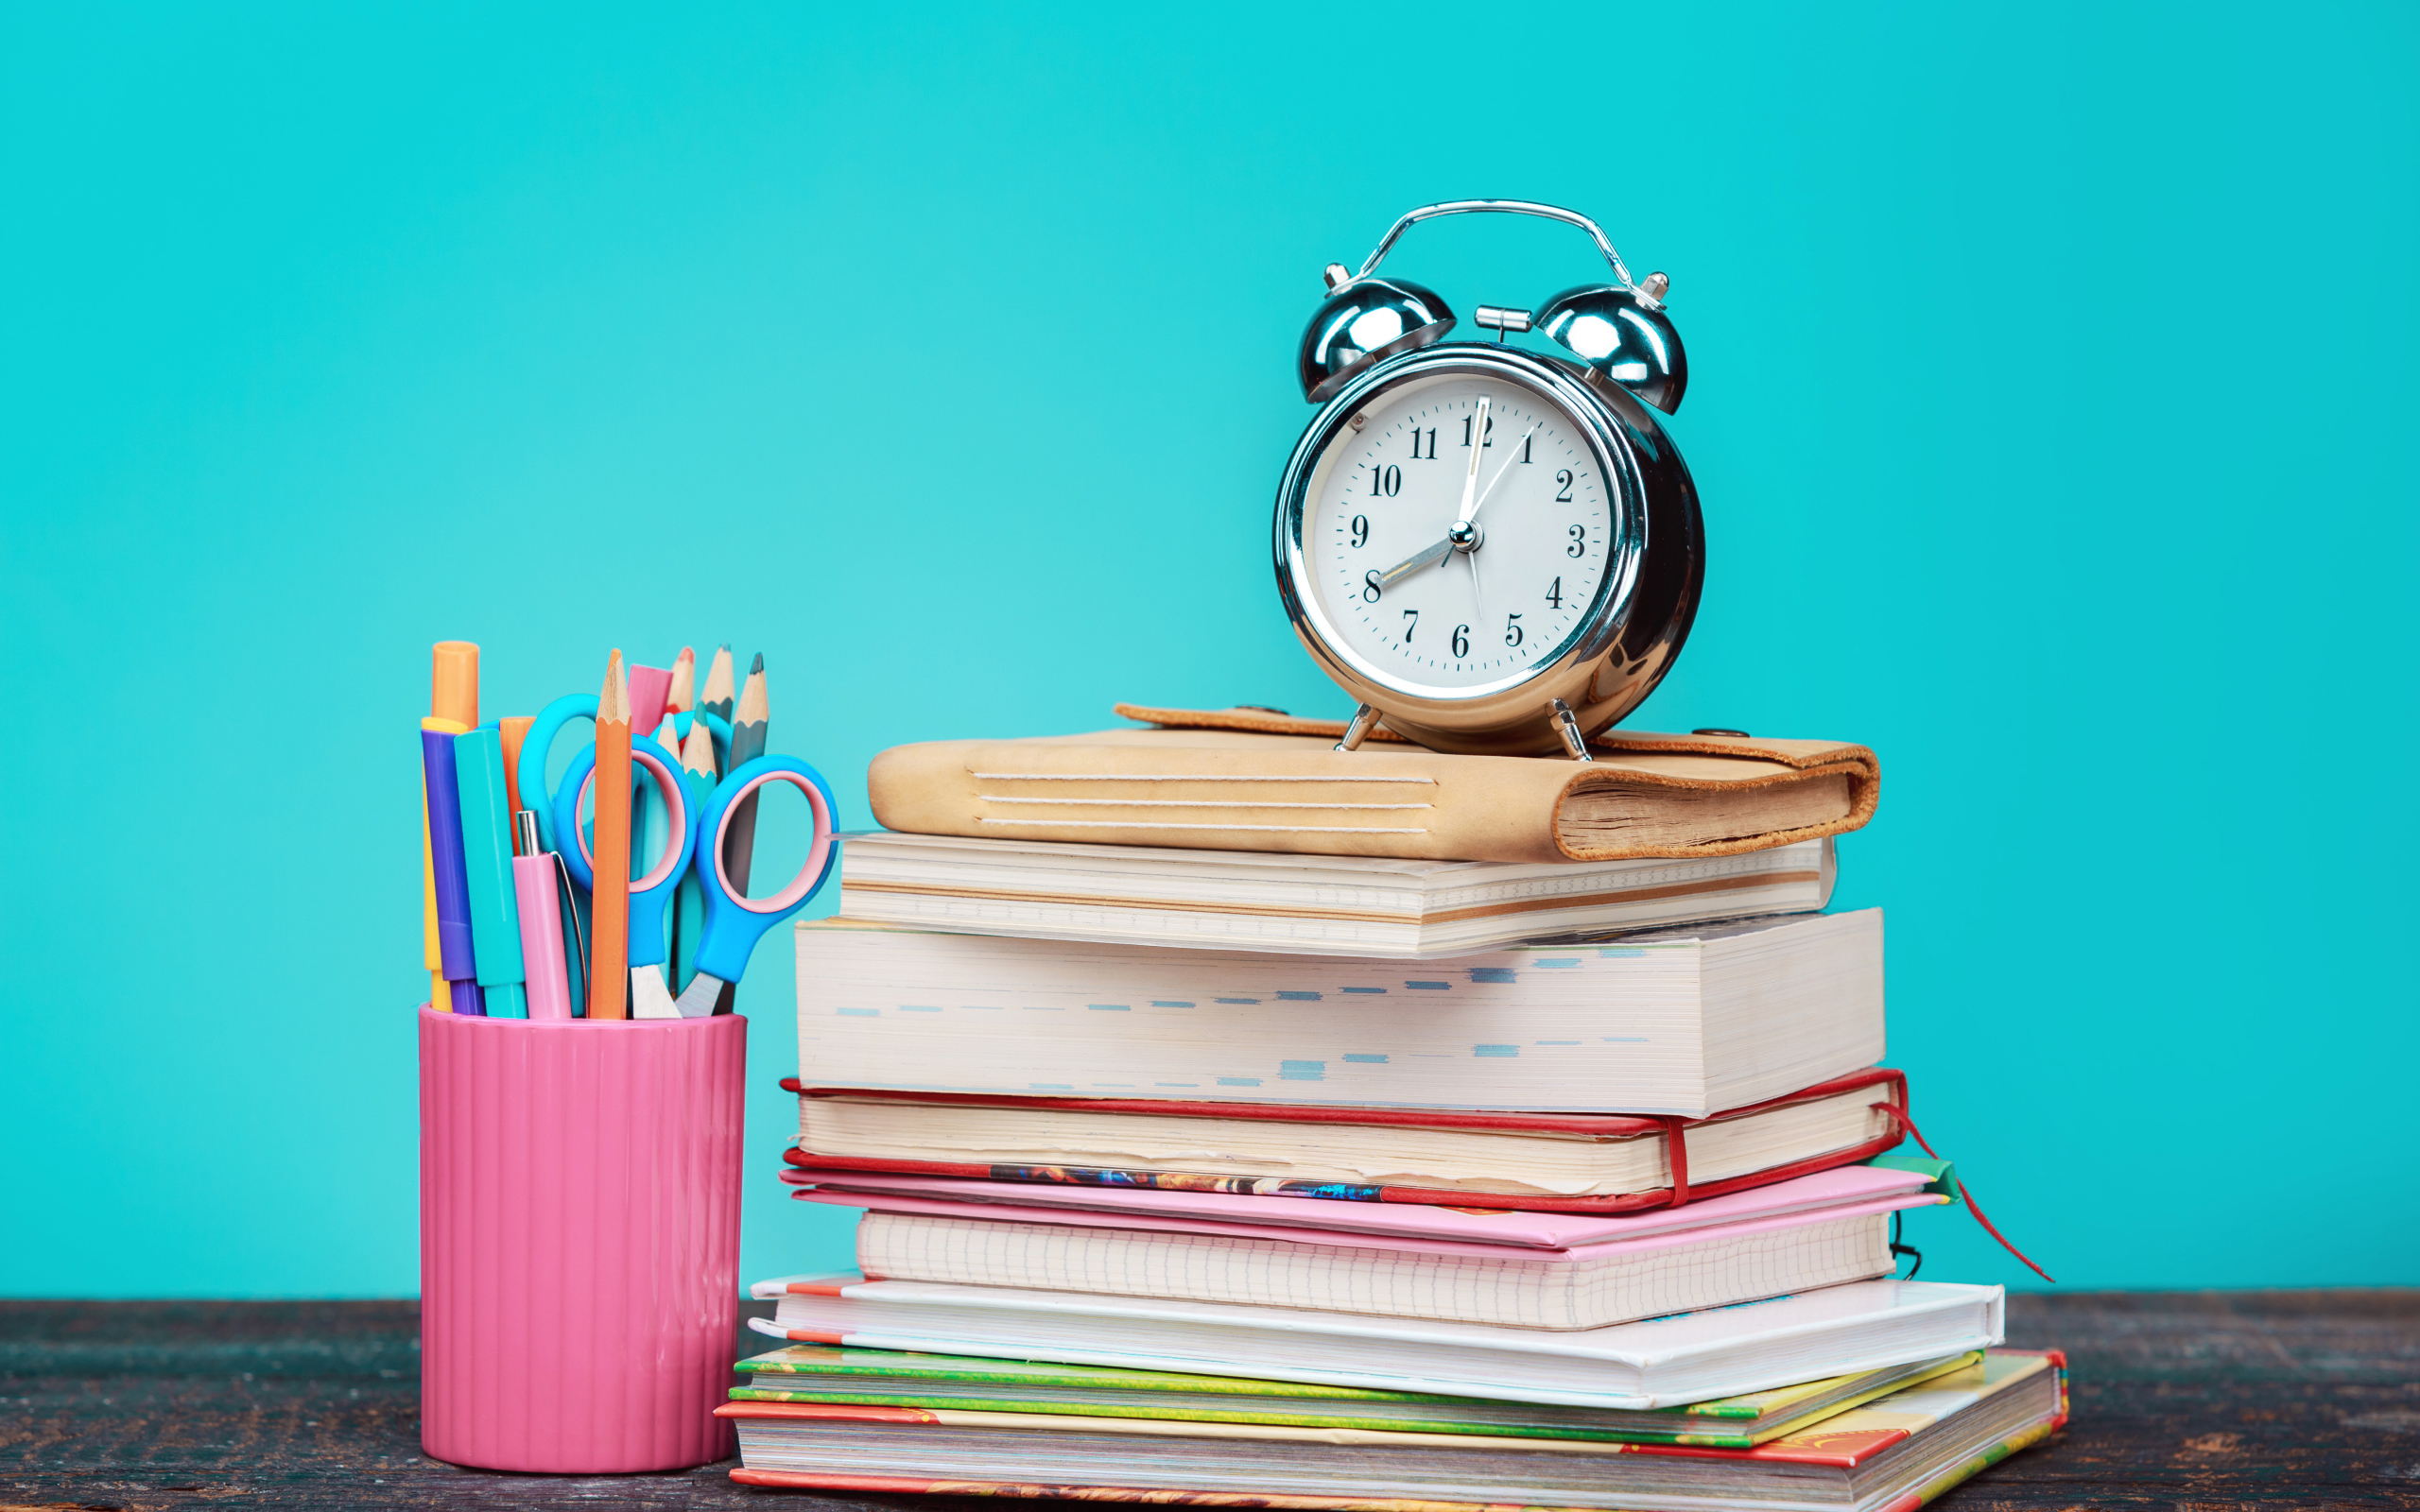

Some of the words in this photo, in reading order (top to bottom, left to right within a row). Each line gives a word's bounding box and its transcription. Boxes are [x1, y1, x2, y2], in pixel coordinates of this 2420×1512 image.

[1409, 427, 1438, 459] 11
[1519, 434, 1533, 464] 1
[1369, 464, 1401, 497] 10
[1555, 470, 1573, 503] 2
[1351, 514, 1369, 548] 9
[1567, 524, 1585, 558] 3
[1363, 570, 1381, 603] 8
[1546, 576, 1563, 609] 4
[1403, 610, 1419, 643] 7
[1451, 625, 1469, 658] 6
[1505, 613, 1523, 646] 5
